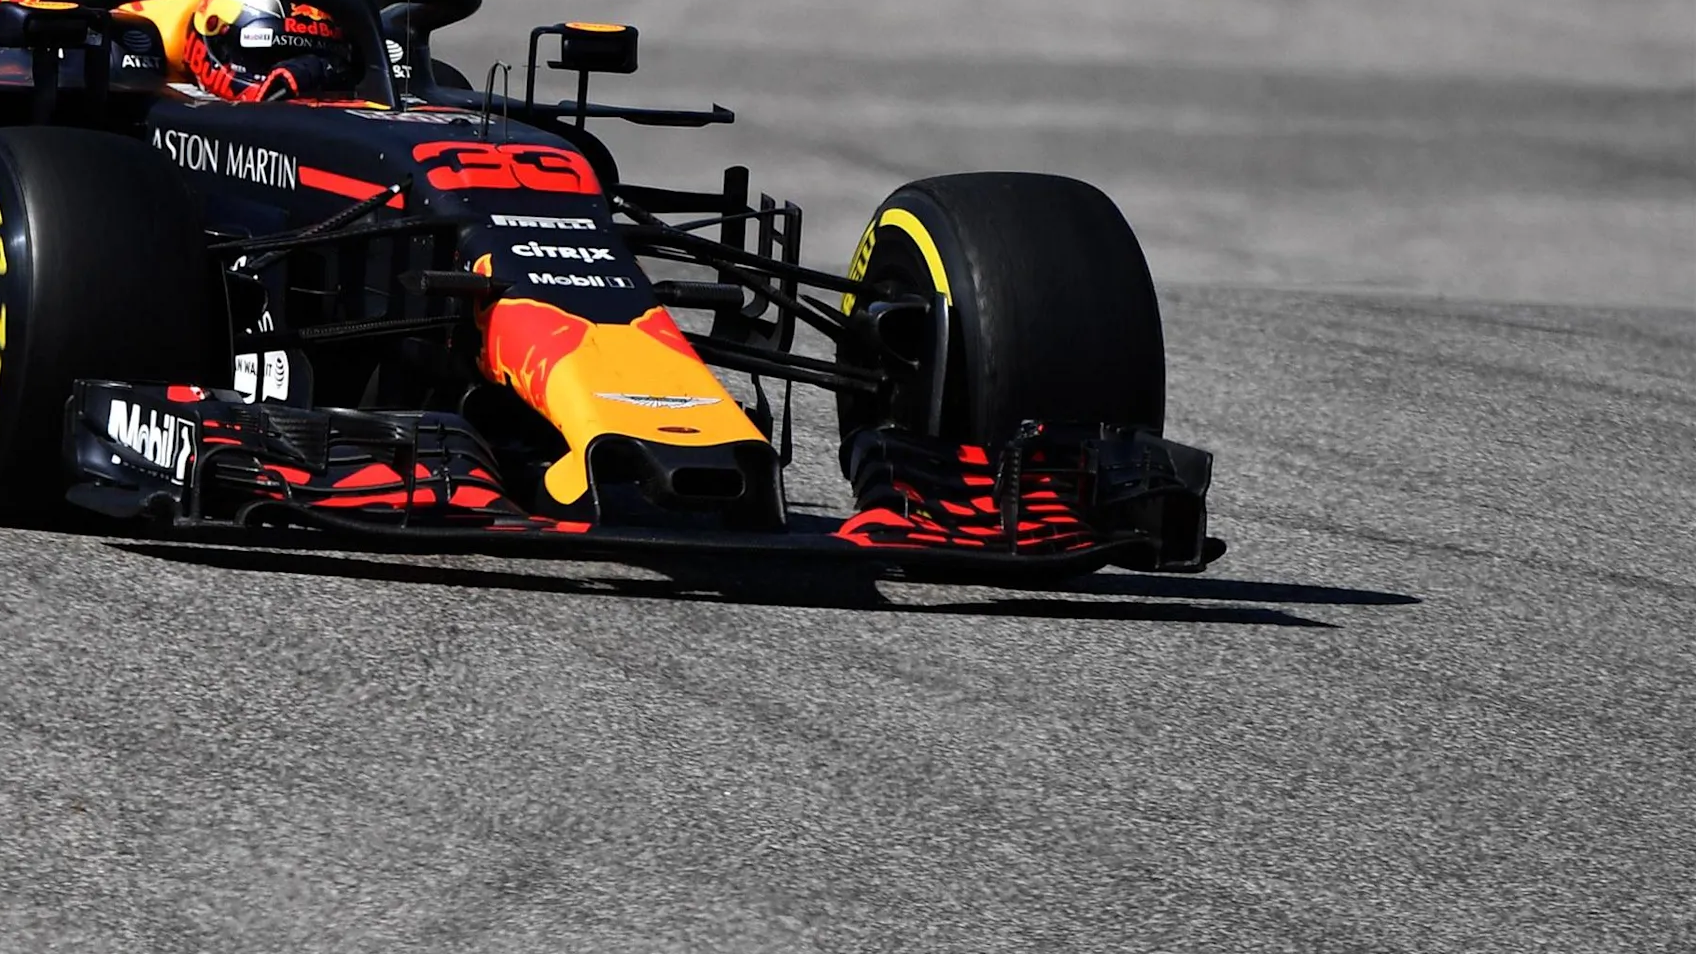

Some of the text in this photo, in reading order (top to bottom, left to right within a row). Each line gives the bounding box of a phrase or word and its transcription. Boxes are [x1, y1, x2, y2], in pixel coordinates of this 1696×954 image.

[284, 17, 318, 36] Red
[271, 34, 313, 48] ASTON
[121, 54, 162, 69] AT&T
[392, 65, 413, 79] &T
[225, 142, 296, 191] MARTIN
[412, 140, 603, 195] 33
[490, 214, 597, 230] PIRELLI
[528, 272, 606, 287] Mobil
[107, 399, 176, 469] Mobil
